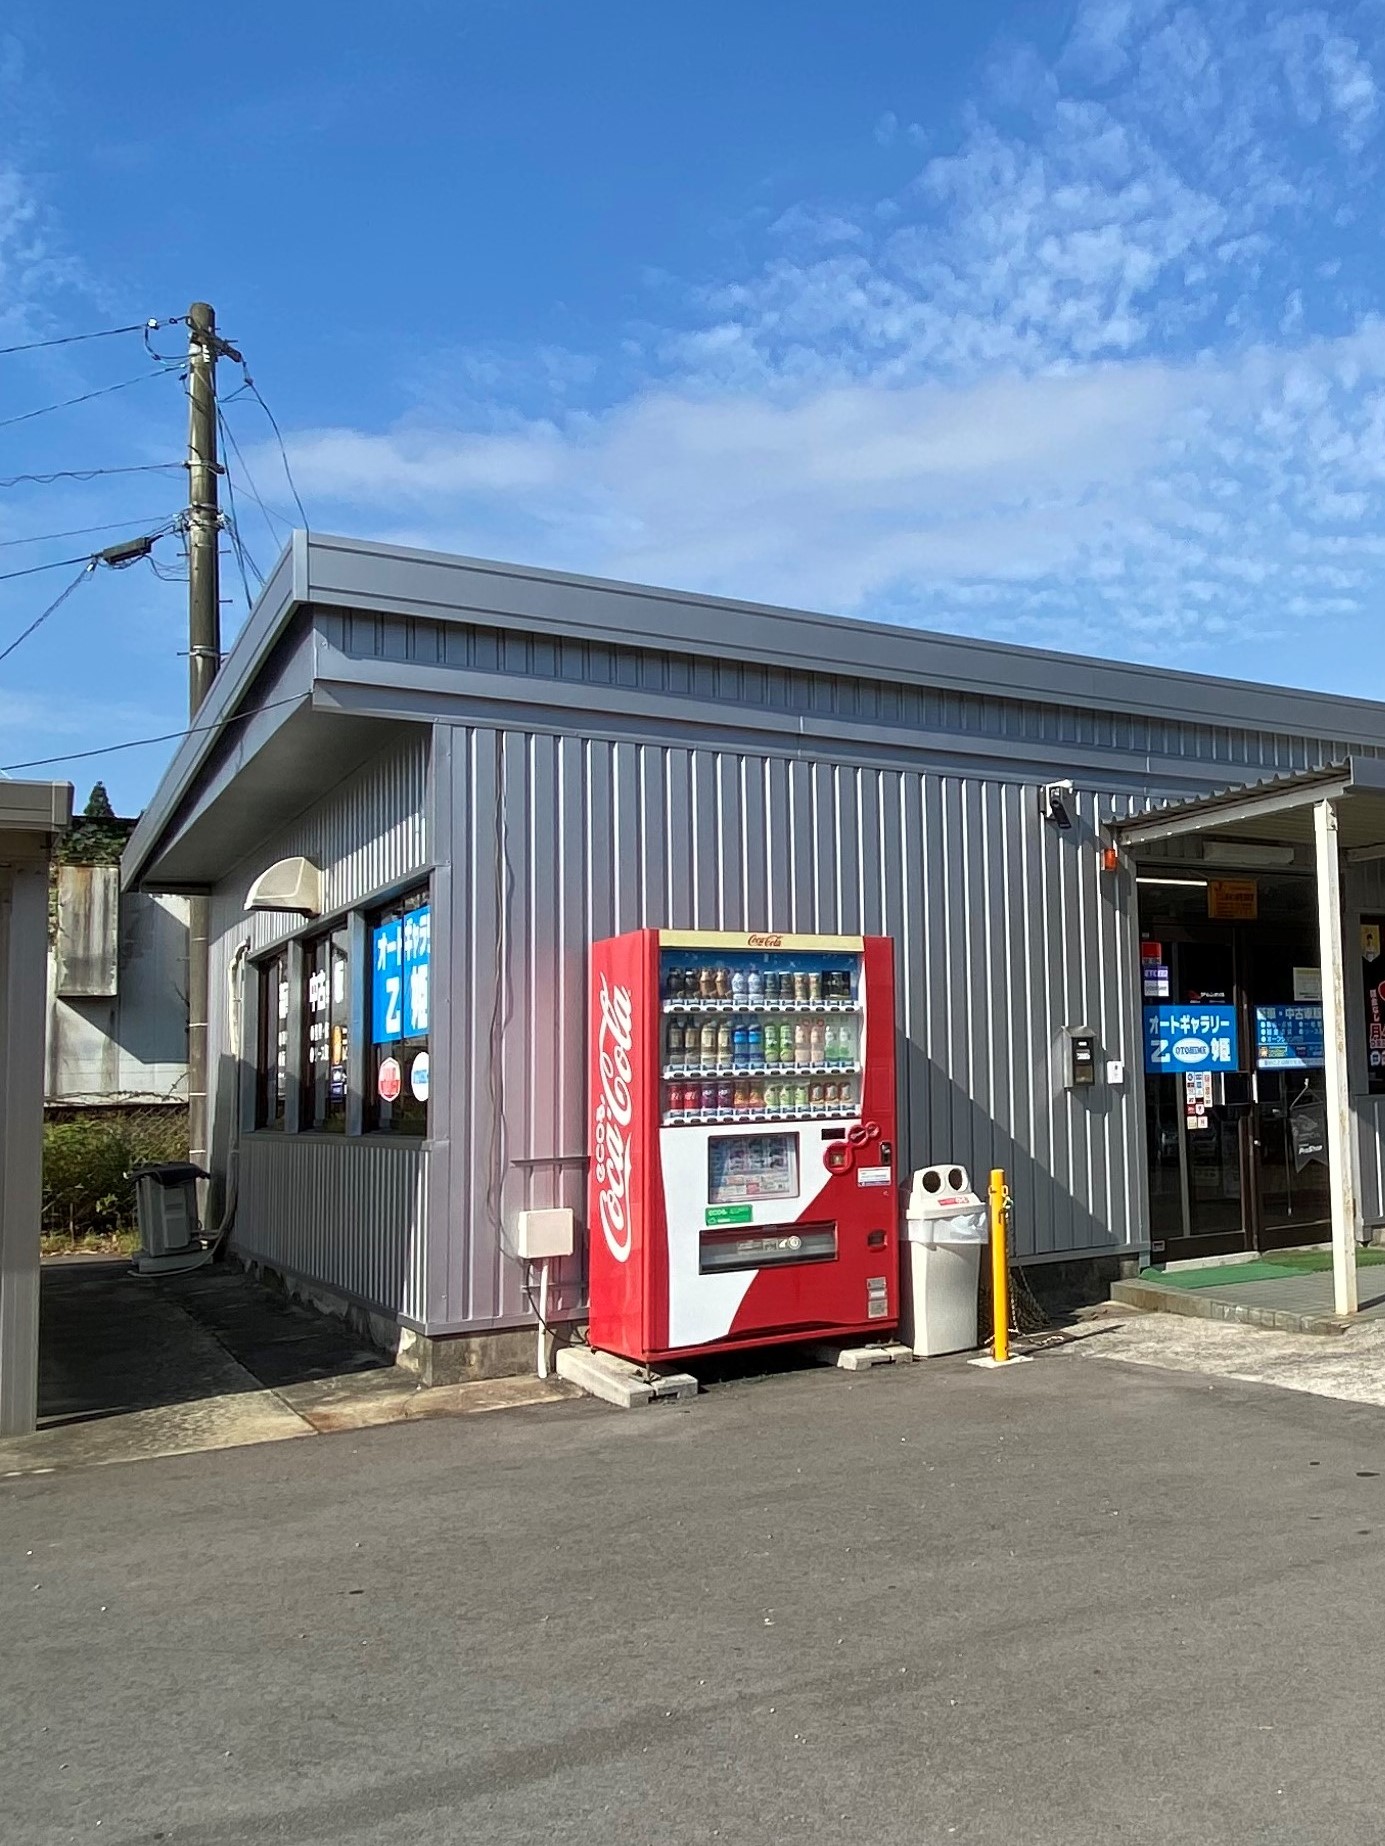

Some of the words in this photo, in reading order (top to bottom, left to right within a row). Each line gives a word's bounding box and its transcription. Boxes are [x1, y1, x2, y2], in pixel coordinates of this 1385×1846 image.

[1149, 1014, 1230, 1034] オートギャラリー
[599, 971, 632, 1262] Coca-Cola
